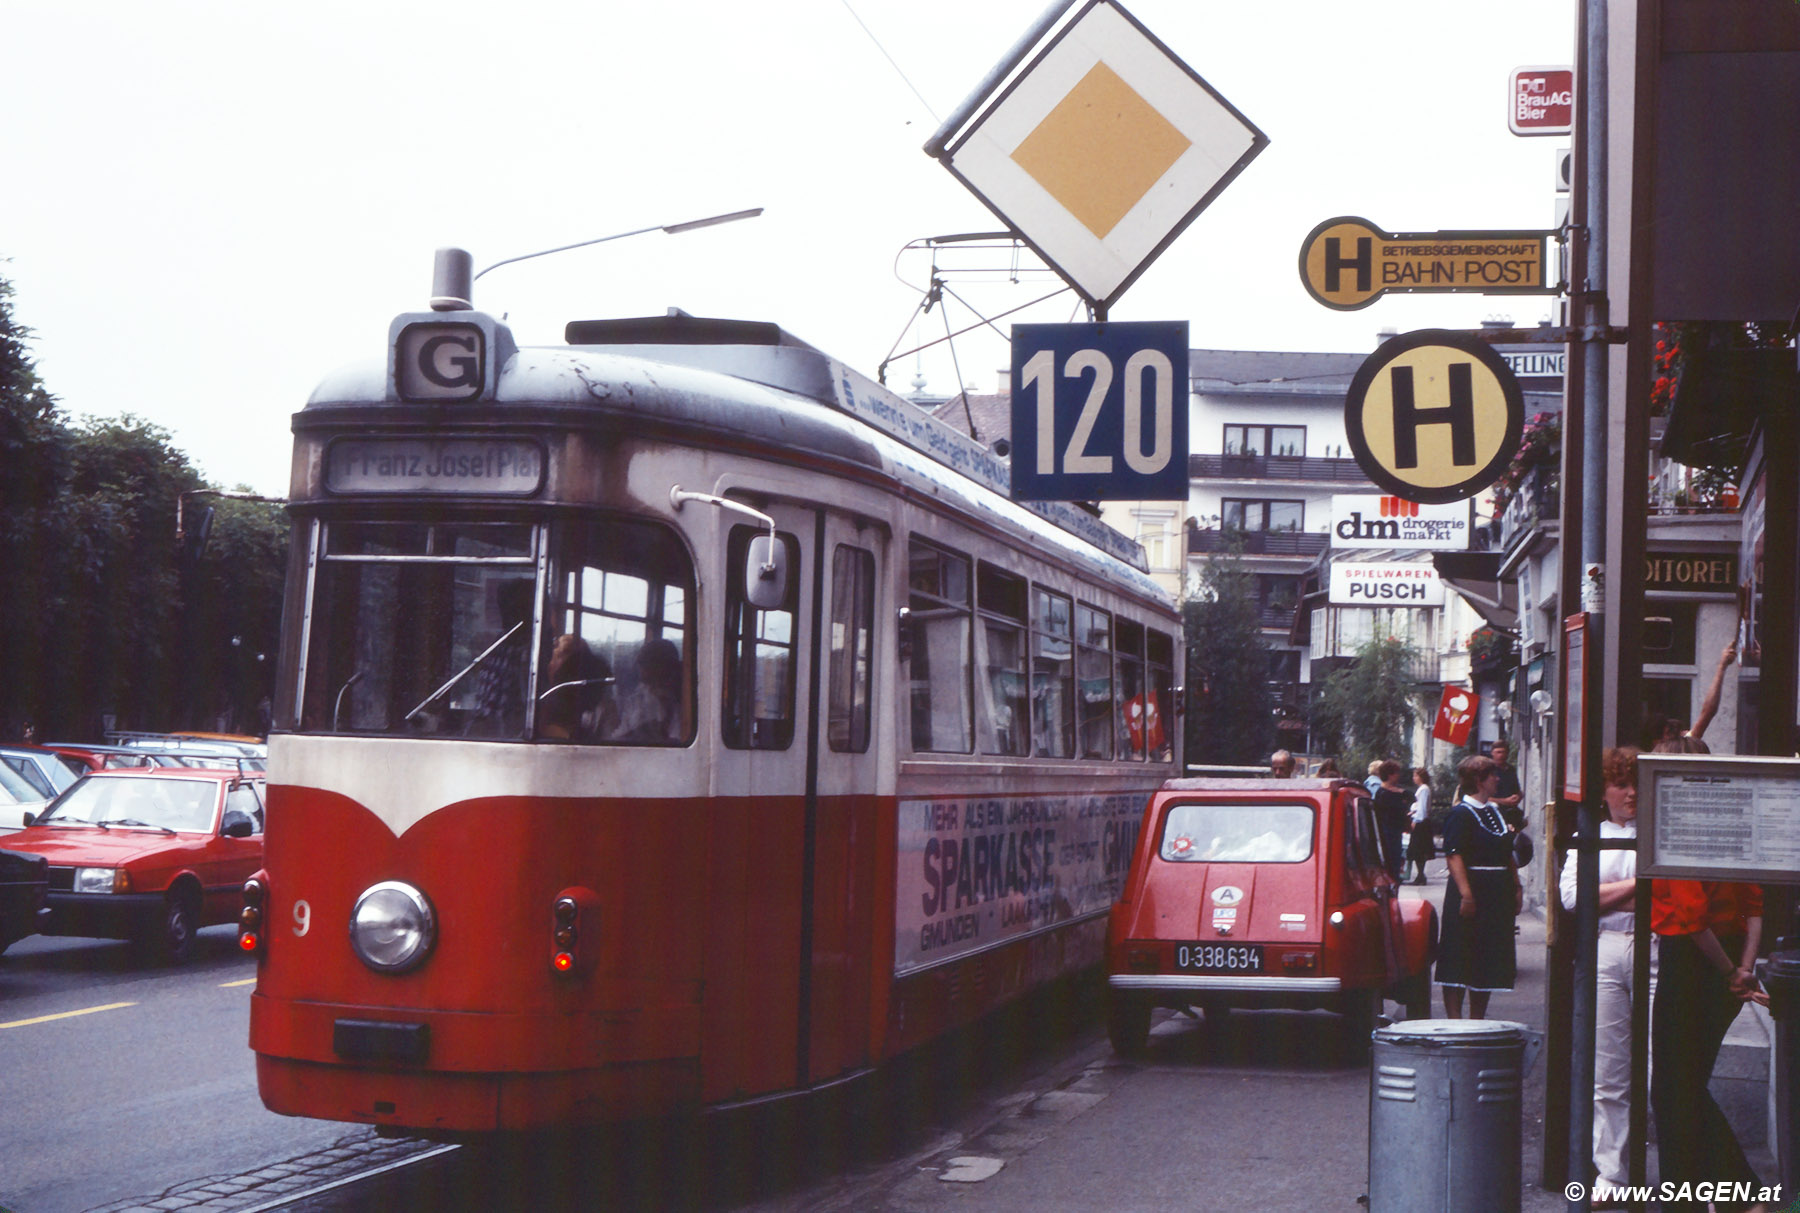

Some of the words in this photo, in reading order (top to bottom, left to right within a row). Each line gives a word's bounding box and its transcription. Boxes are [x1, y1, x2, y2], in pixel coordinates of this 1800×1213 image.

[1516, 107, 1547, 121] Bier
[1325, 237, 1372, 292] H
[1382, 244, 1537, 256] BETRIEBSGEMEINSCHAFT
[418, 336, 477, 389] G
[1021, 348, 1174, 476] 120
[1391, 362, 1476, 470] H
[345, 449, 422, 477] Franz
[425, 448, 493, 478] Josef
[1336, 511, 1400, 540] dm
[1402, 516, 1465, 535] drogerie
[1403, 529, 1451, 540] markt
[1345, 569, 1432, 579] SPIELWAREN
[1350, 582, 1426, 600] PUSCH
[924, 804, 958, 831] MEHR
[965, 802, 985, 829] ALS
[987, 800, 1004, 826] EIN
[922, 827, 1056, 917] SPARKASSE
[1220, 888, 1234, 900] A
[293, 899, 311, 937] 9
[921, 911, 980, 952] GMUNDEN
